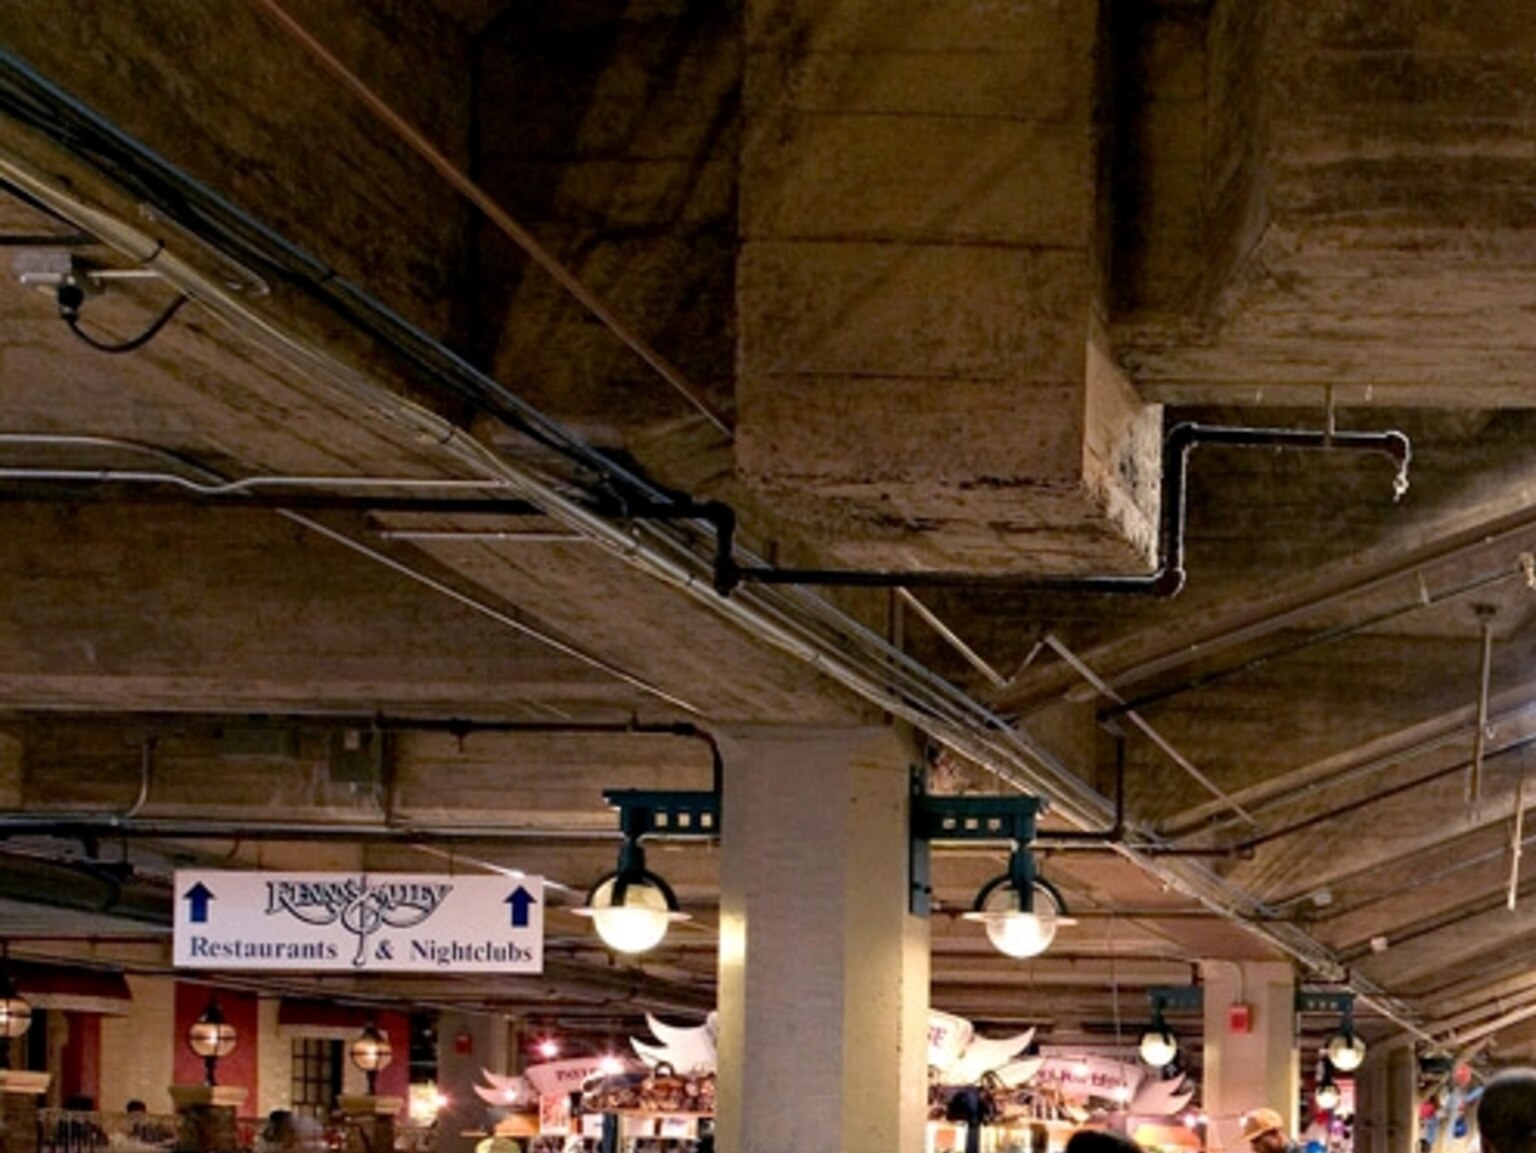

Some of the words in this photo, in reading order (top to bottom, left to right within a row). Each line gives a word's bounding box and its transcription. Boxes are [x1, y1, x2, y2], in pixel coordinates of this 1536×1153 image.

[190, 936, 338, 960] Restaurants
[375, 939, 395, 961] &
[411, 939, 533, 965] Nightclubs
